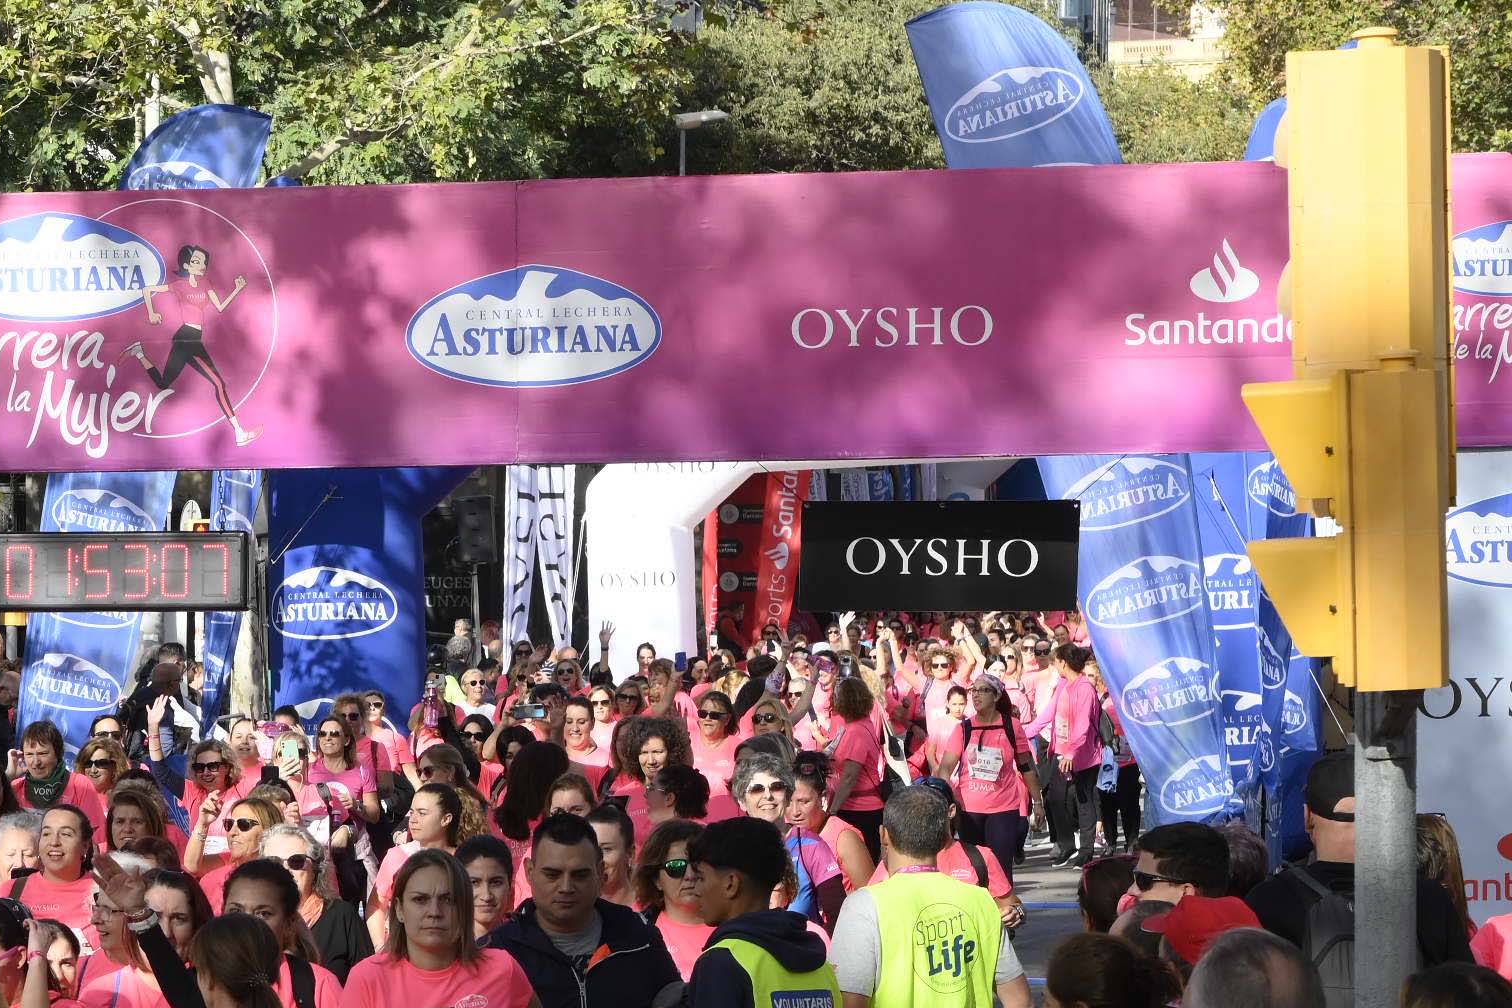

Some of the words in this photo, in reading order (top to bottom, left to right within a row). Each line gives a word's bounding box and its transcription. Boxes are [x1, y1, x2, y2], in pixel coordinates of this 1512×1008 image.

[69, 249, 140, 260] LECHERA
[465, 308, 544, 321] CENTRAL
[551, 305, 633, 318] LECHERA
[791, 305, 993, 348] OYSHO
[1124, 311, 1295, 346] Santand
[426, 312, 641, 357] ASTURIANA
[6, 373, 31, 413] la
[25, 363, 176, 459] Mujer
[772, 470, 799, 539] Santa
[845, 537, 1039, 577] OYSHO
[287, 591, 330, 601] CENTRAL
[334, 590, 384, 600] LECHERA
[600, 569, 676, 588] OYSHO
[275, 596, 389, 624] ASTURIANA
[769, 574, 787, 627] ports
[968, 780, 996, 792] SUMA
[915, 911, 967, 947] Sport
[926, 933, 976, 978] Life
